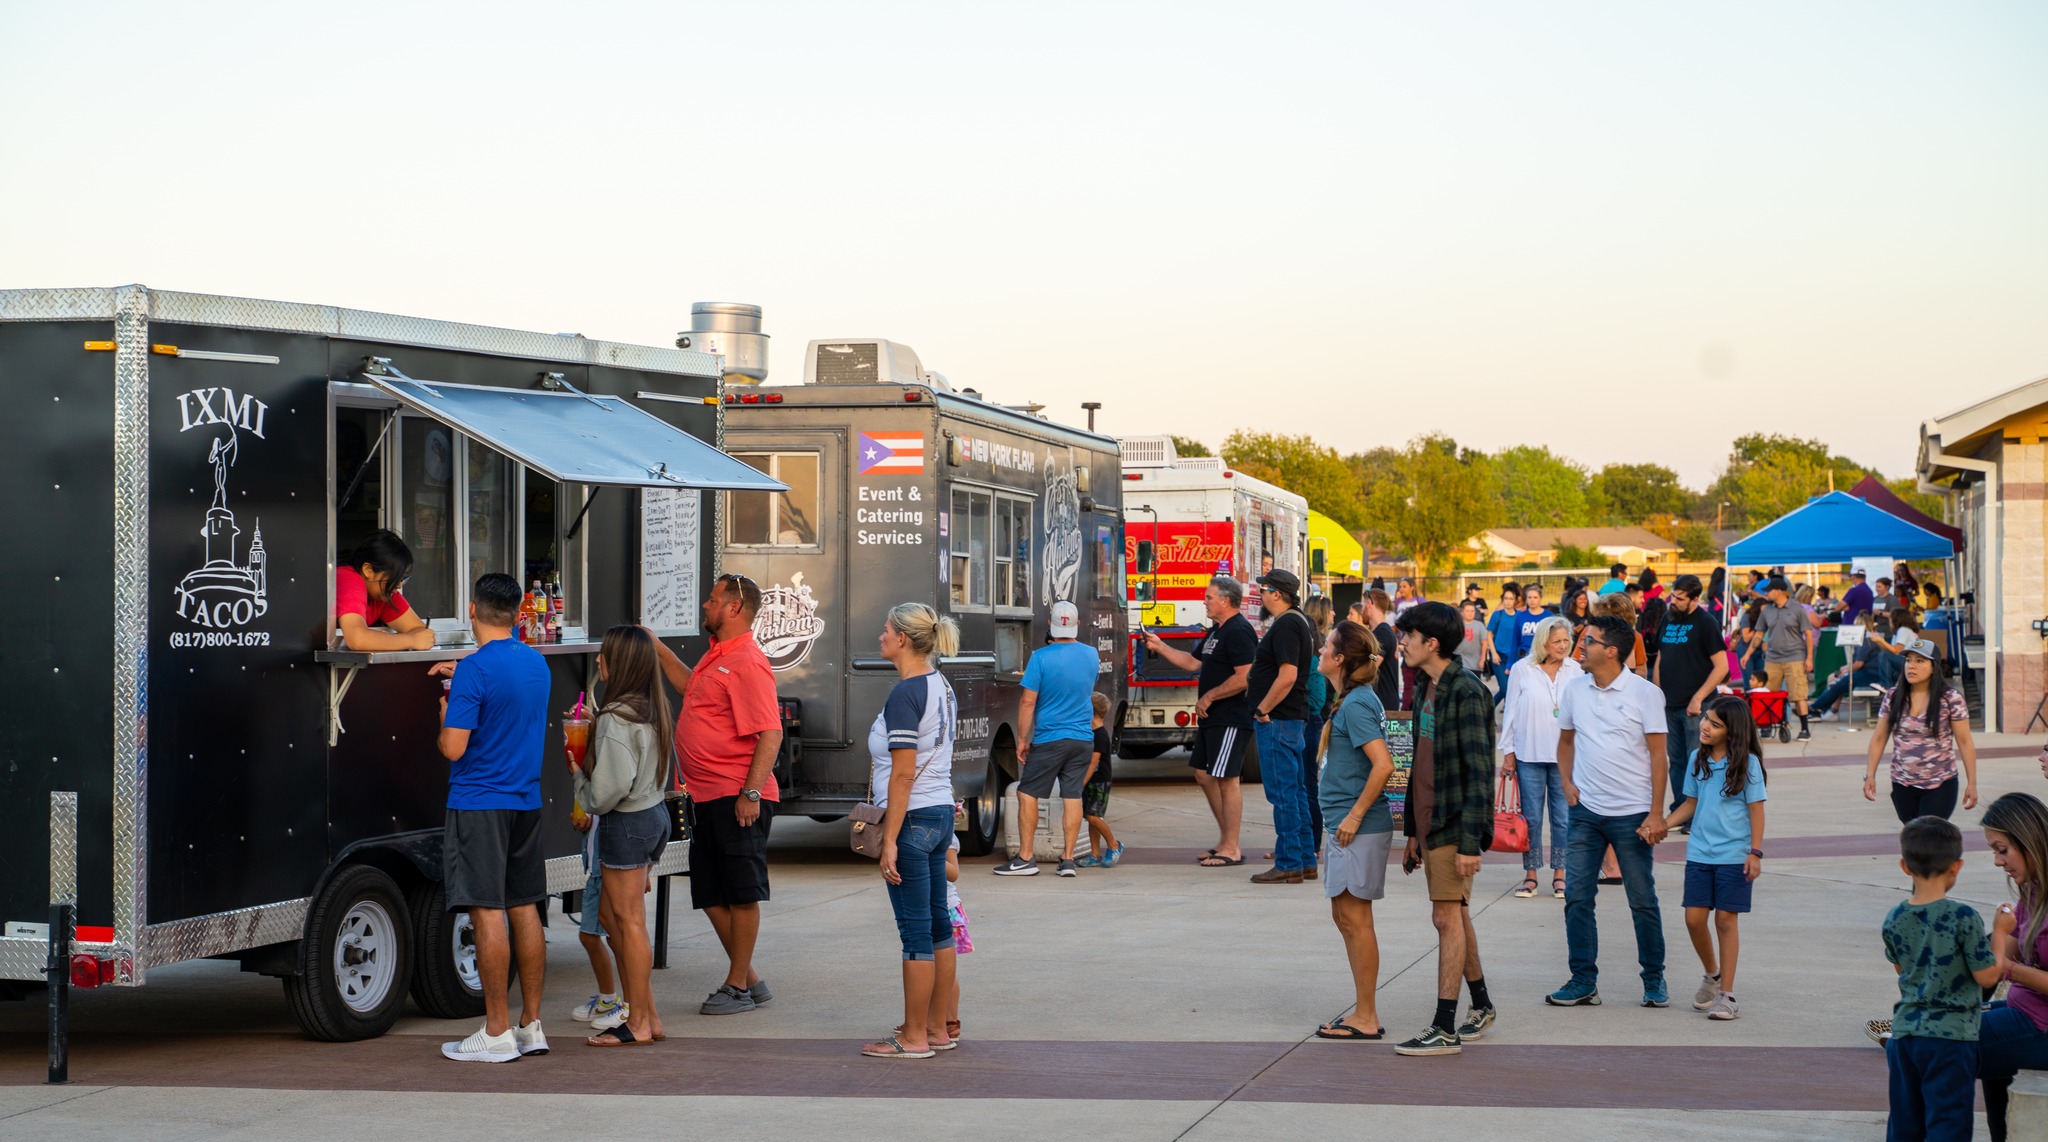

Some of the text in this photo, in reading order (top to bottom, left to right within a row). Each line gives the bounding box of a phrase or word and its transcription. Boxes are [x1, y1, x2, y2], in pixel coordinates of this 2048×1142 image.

[176, 387, 268, 439] IXMI
[971, 437, 989, 463] NEW
[990, 441, 1011, 469] YORK
[858, 486, 921, 501] Event &
[857, 508, 922, 525] Catering
[857, 530, 922, 545] Services
[1125, 536, 1181, 570] Sgar
[1172, 576, 1196, 585] Hero
[174, 586, 268, 628] TACOS
[1061, 616, 1070, 626] T
[169, 632, 271, 648] (817)800-1672
